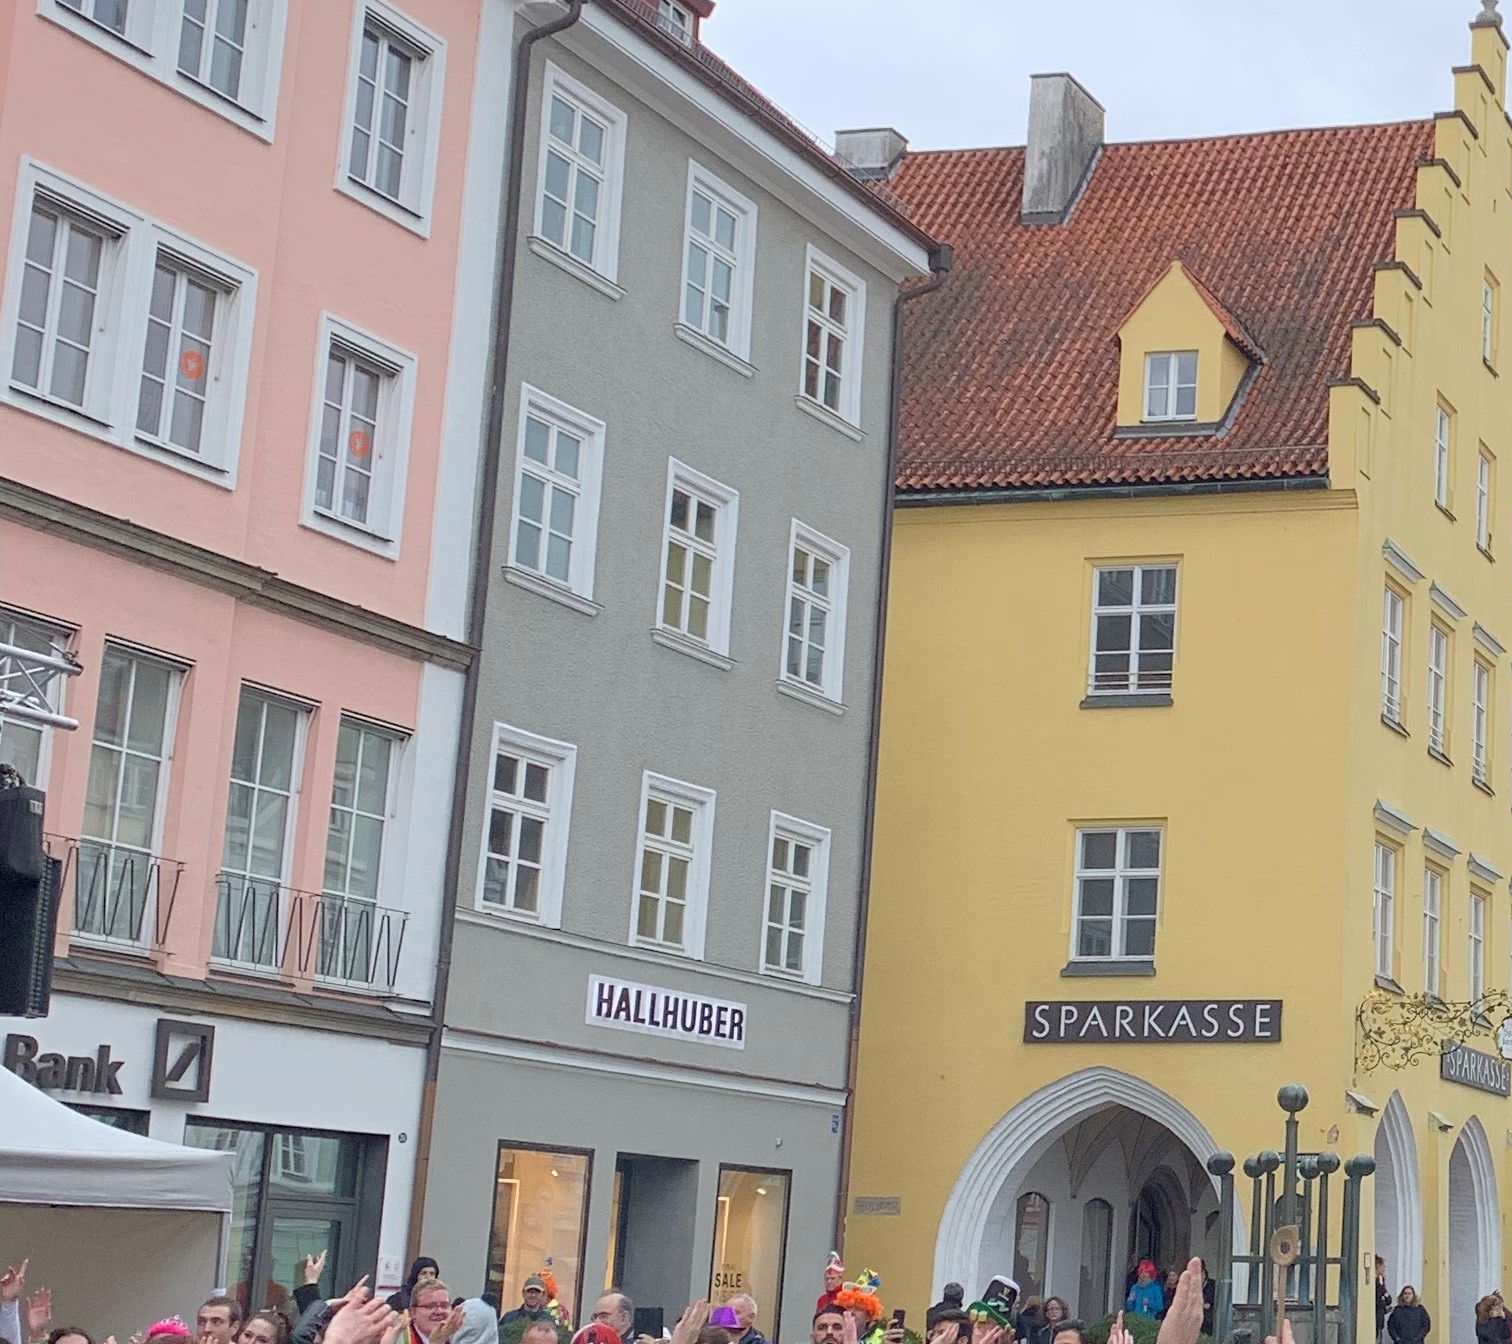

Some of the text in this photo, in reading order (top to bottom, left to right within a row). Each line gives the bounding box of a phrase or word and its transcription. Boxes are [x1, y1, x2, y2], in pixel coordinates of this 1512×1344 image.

[595, 982, 744, 1041] HALLHUBER
[1032, 1004, 1271, 1038] SPARKASSE
[4, 1033, 125, 1095] Bank
[1449, 1045, 1507, 1091] SPARKASSE
[714, 1272, 742, 1288] SALE
